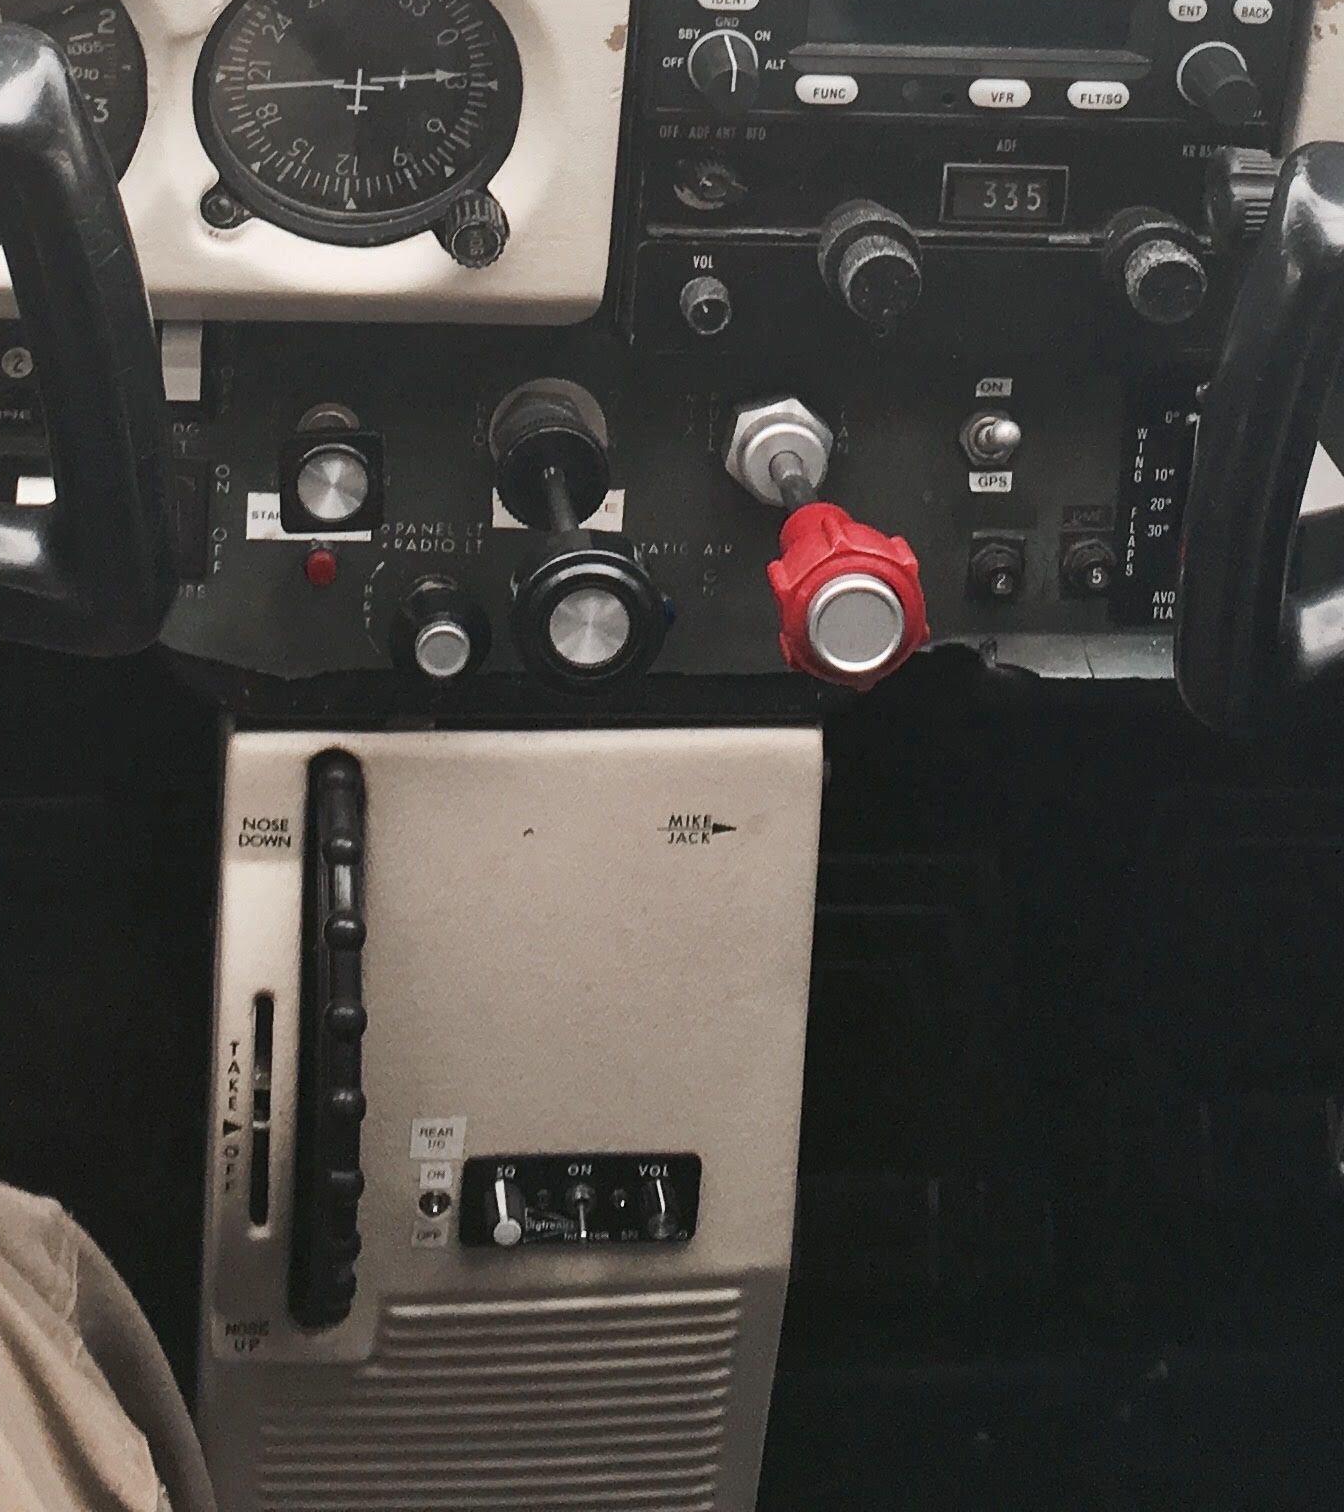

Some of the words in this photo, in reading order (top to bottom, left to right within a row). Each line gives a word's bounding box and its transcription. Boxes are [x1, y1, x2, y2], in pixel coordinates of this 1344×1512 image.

[1177, 4, 1201, 17] ENT
[1241, 6, 1270, 19] BACK
[678, 28, 701, 40] SBY
[755, 30, 772, 42] ON
[662, 57, 684, 68] OFF
[765, 58, 786, 69] ALT
[812, 87, 846, 100] FUNC
[990, 91, 1014, 104] VFR
[1079, 92, 1122, 107] FLT/SQ
[984, 180, 1043, 212] 335
[694, 256, 714, 269] VOL
[981, 382, 1003, 392] ON
[979, 476, 1007, 487] GPS
[395, 524, 454, 535] PANEL
[394, 539, 455, 551] RADIO
[243, 817, 288, 832] NOSE
[668, 814, 712, 828] MIKE
[239, 833, 292, 848] DOWN
[667, 831, 711, 845] JACK
[568, 1165, 592, 1176] ON
[638, 1165, 669, 1177] VOL
